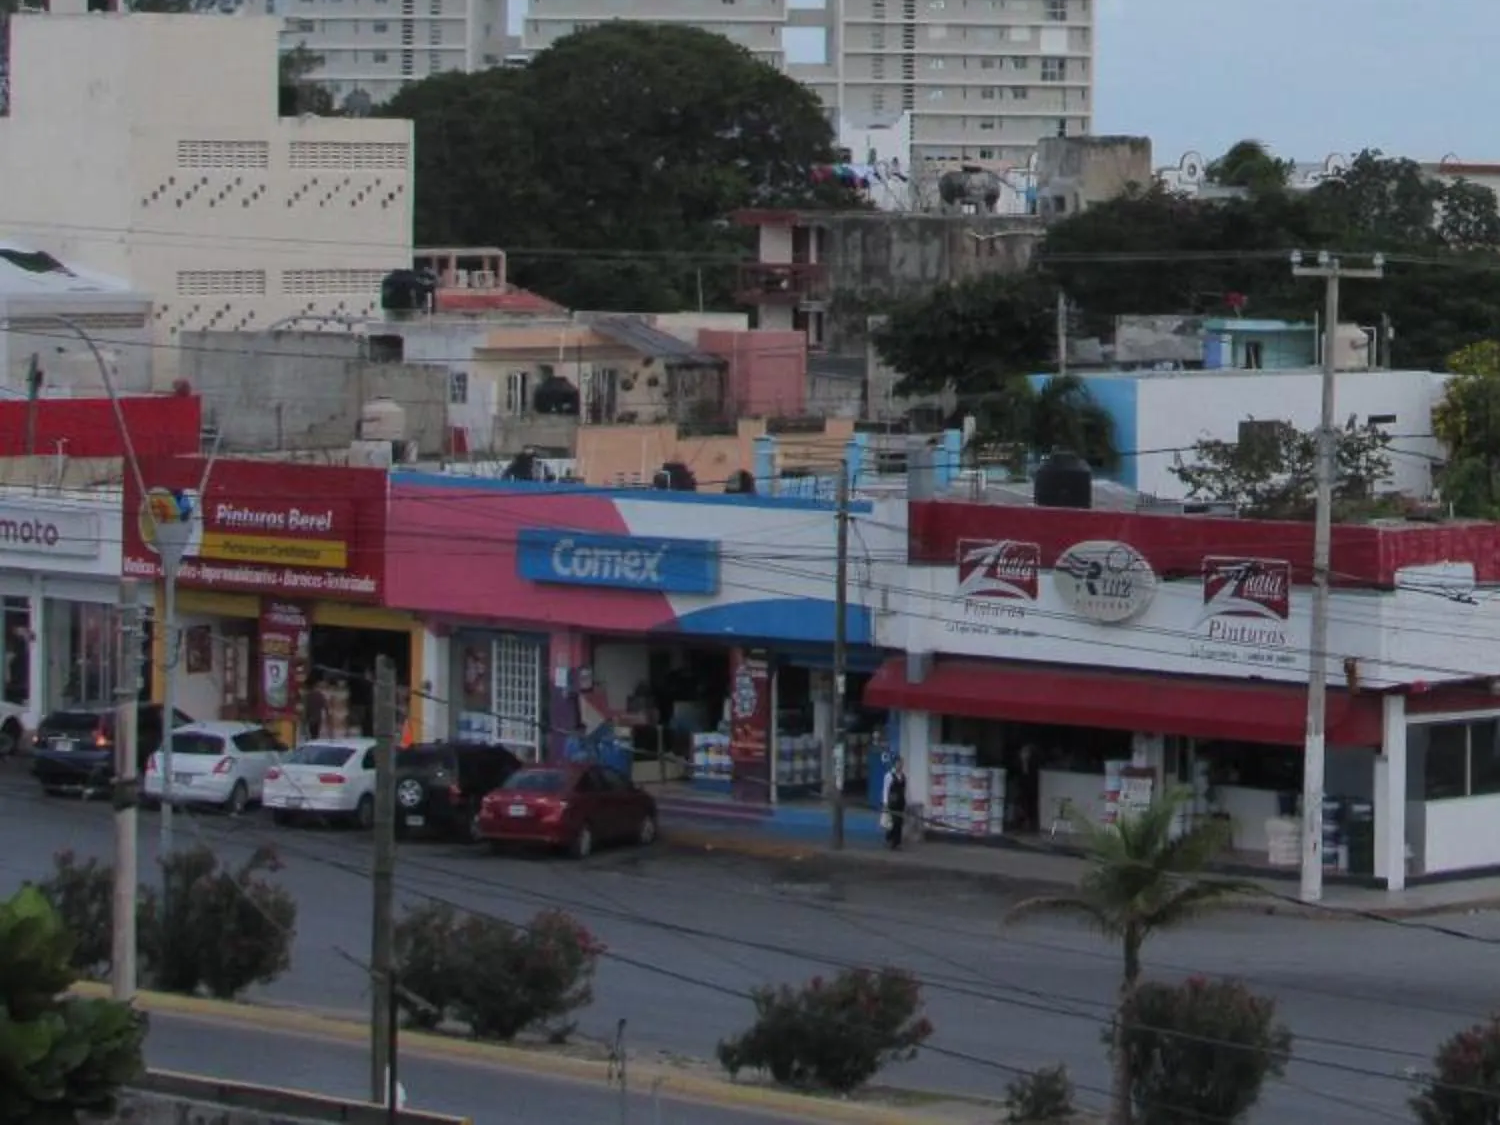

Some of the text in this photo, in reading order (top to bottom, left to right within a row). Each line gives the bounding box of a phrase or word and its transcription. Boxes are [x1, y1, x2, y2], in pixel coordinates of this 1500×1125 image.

[289, 509, 333, 531] Berel
[552, 538, 669, 583] Comex
[1207, 618, 1287, 644] Pinturas
